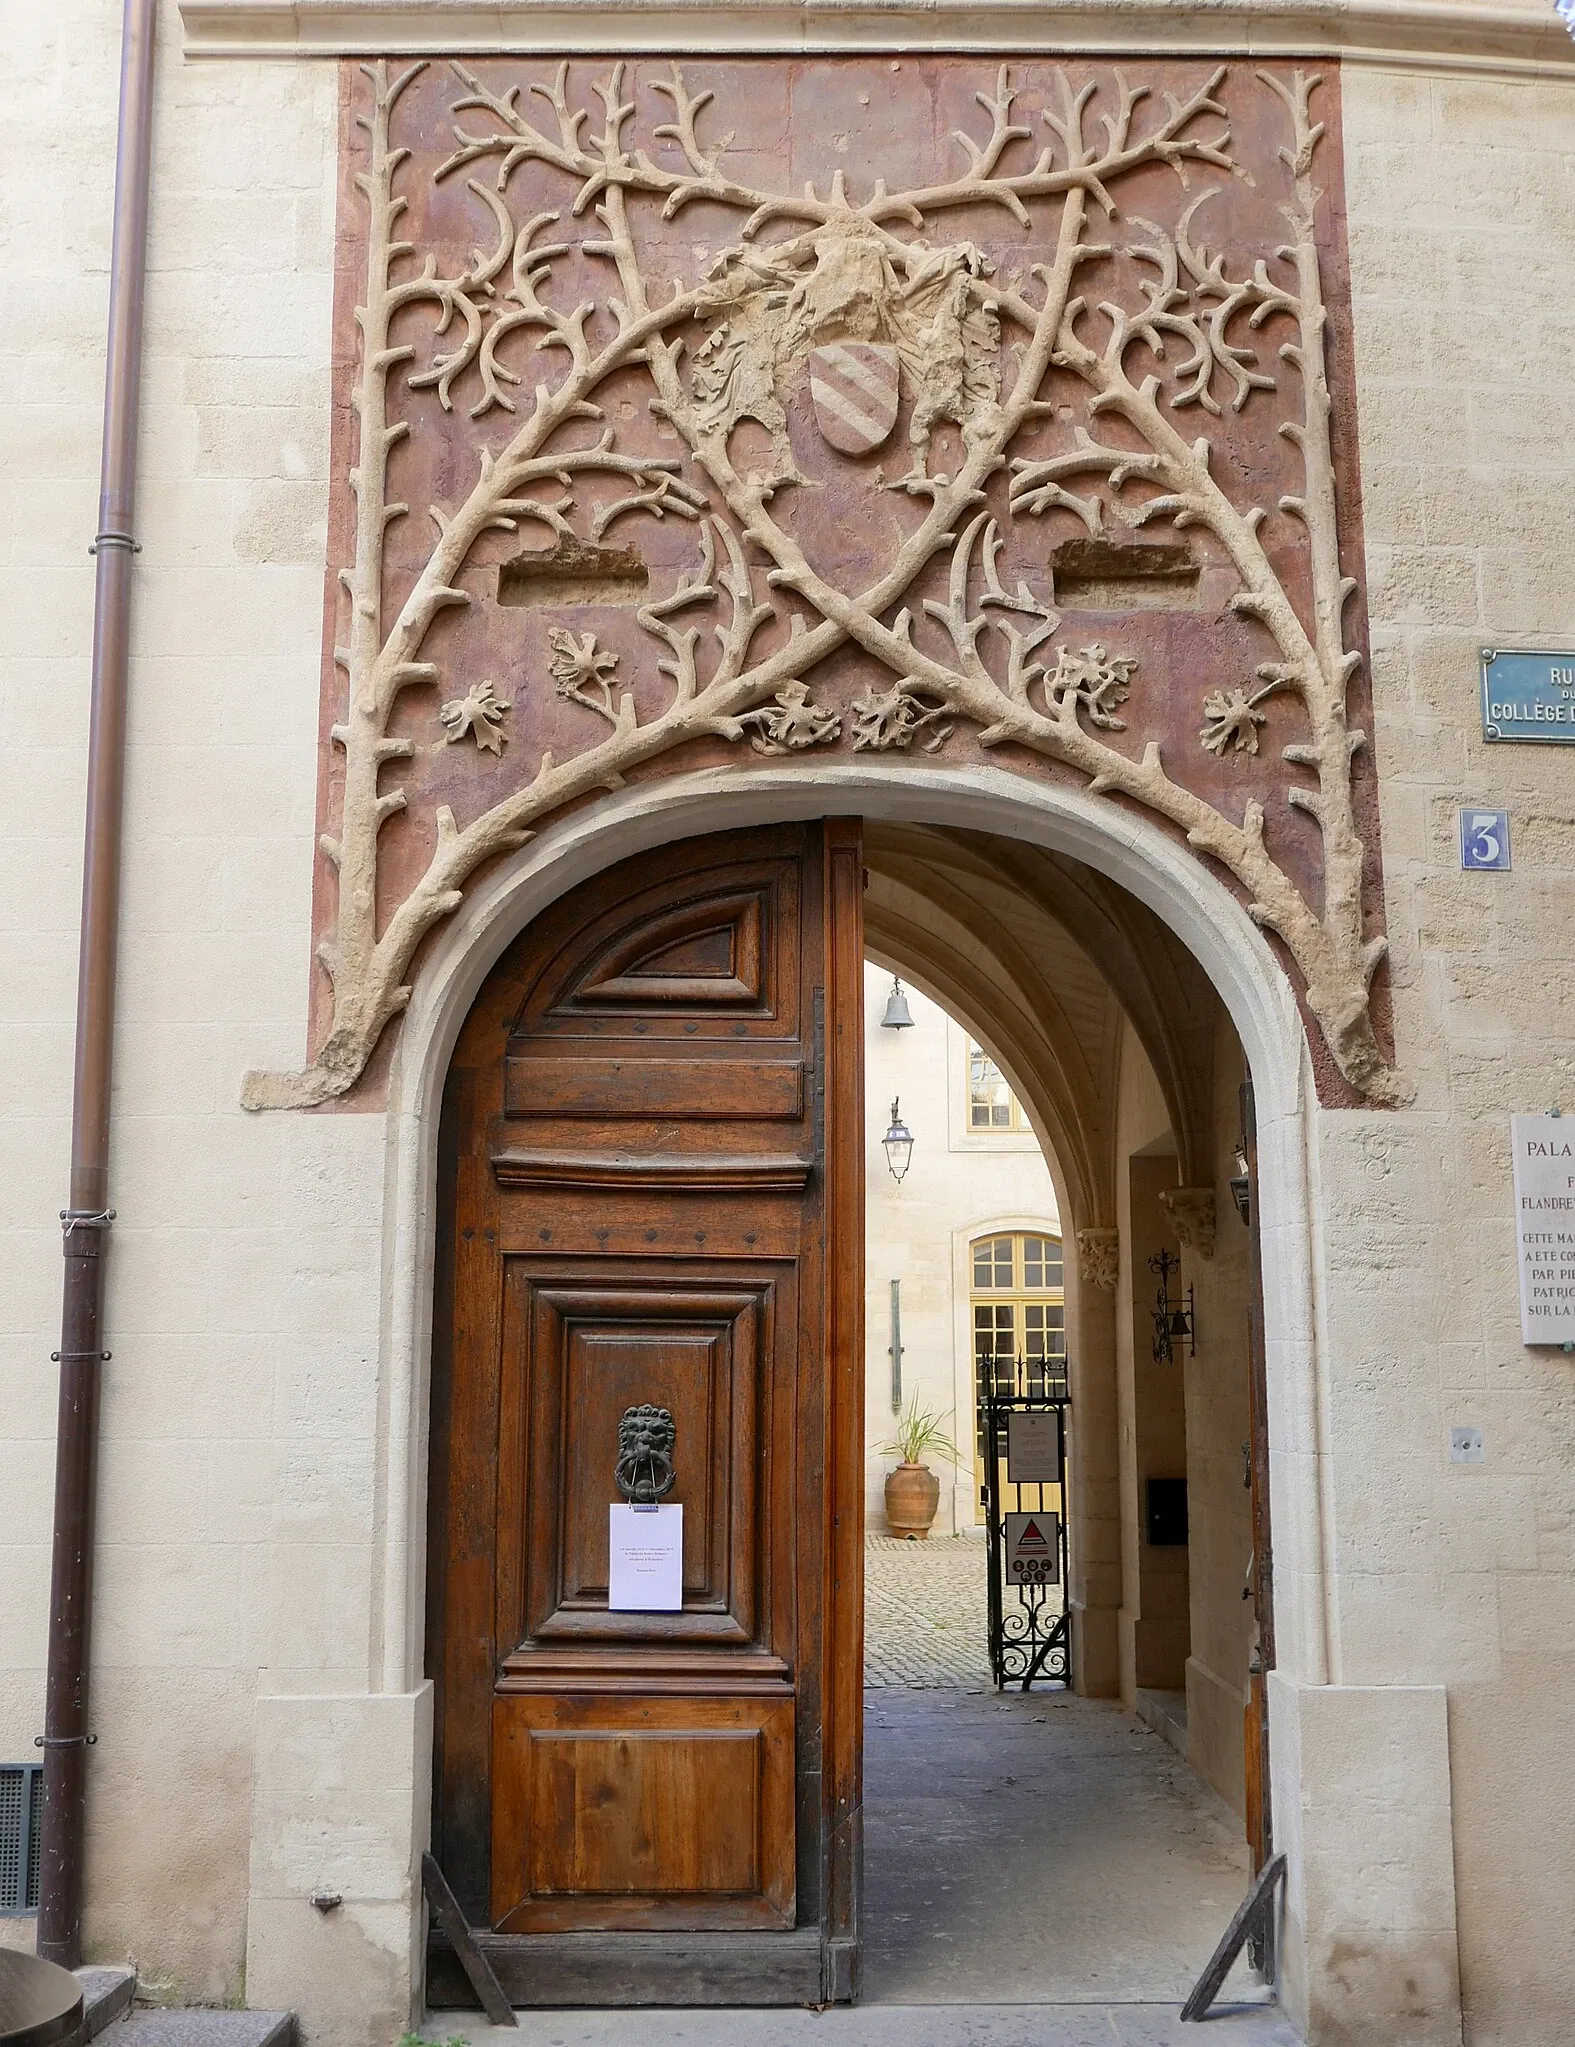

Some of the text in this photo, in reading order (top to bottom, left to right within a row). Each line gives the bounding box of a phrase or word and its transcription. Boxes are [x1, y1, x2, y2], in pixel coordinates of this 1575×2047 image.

[1550, 667, 1573, 685] RU
[1491, 698, 1566, 722] COLLÈGE
[1471, 815, 1500, 862] 3
[1527, 1141, 1575, 1156] PALA
[1522, 1197, 1575, 1210] FLANDRE
[1522, 1233, 1575, 1244] CETTE MA
[1524, 1251, 1575, 1262] A ETE CO
[1532, 1269, 1555, 1280] PAR
[1528, 1305, 1570, 1317] SUR LA
